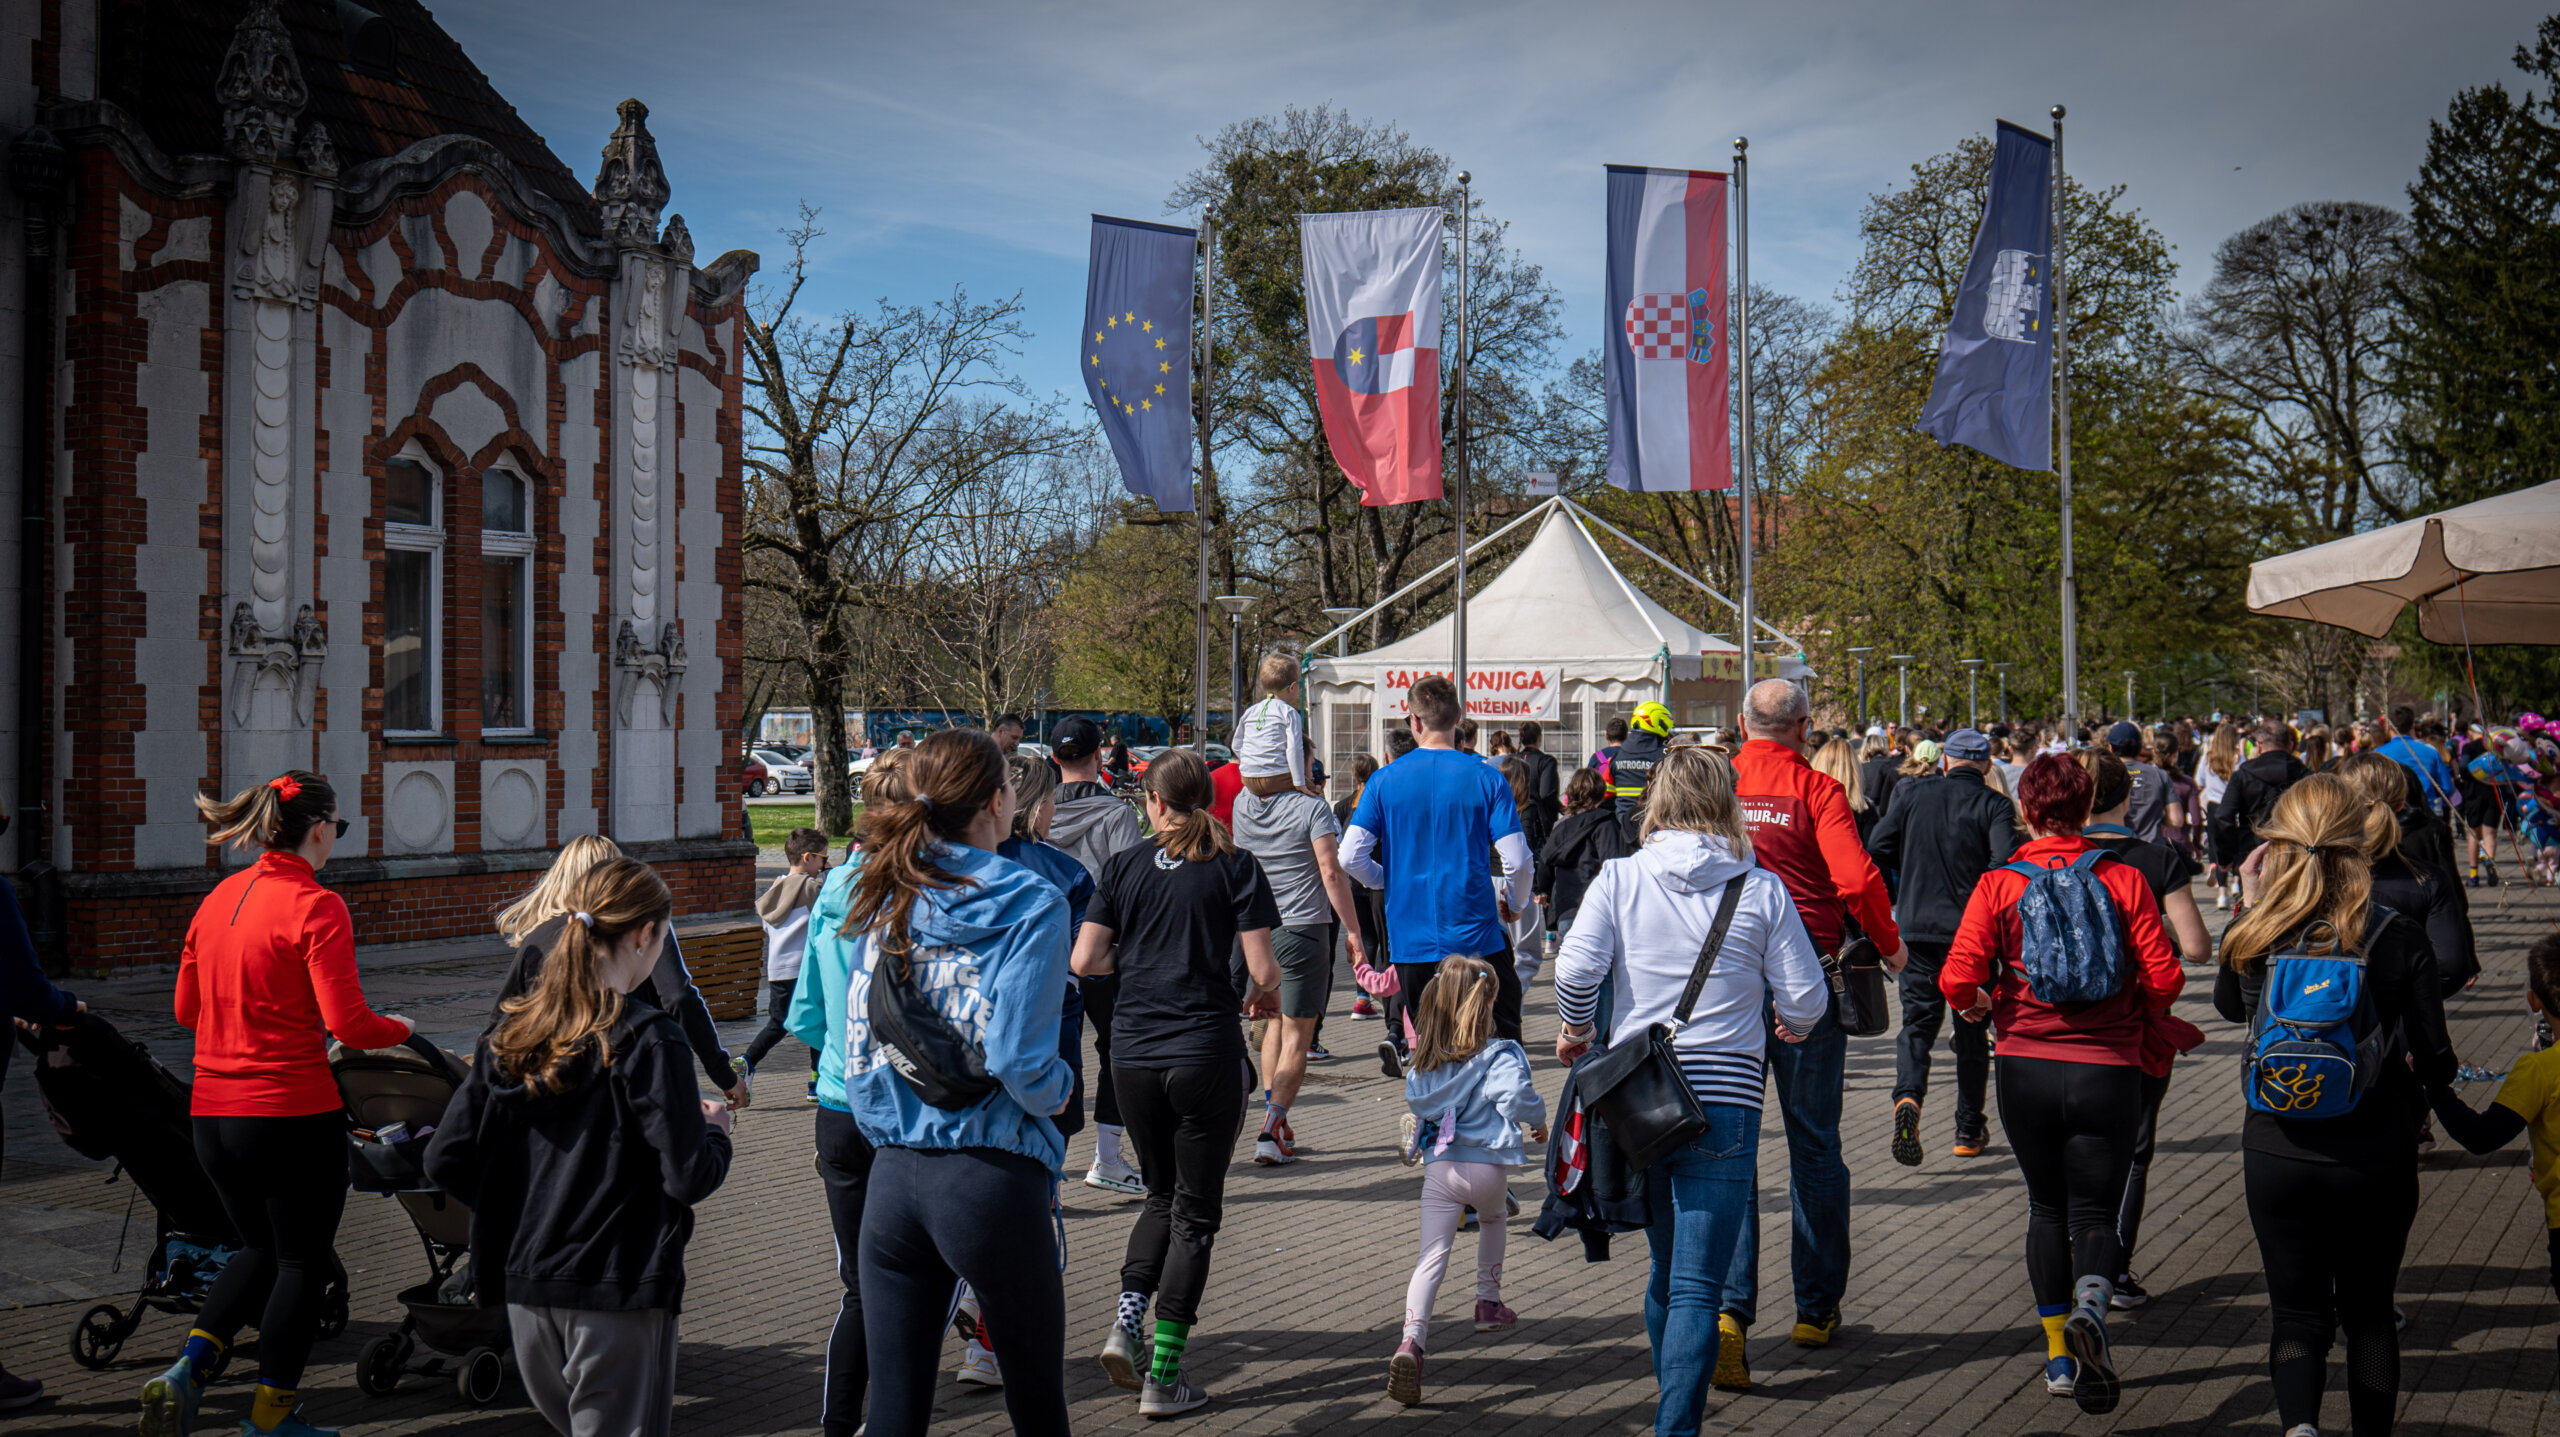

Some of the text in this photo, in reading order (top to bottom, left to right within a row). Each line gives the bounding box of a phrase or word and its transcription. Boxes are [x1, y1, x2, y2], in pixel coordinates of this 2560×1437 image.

[1466, 697, 1531, 716] NIŽENJA
[1743, 809, 1791, 827] MURJE
[882, 1043, 918, 1073] NIKE
